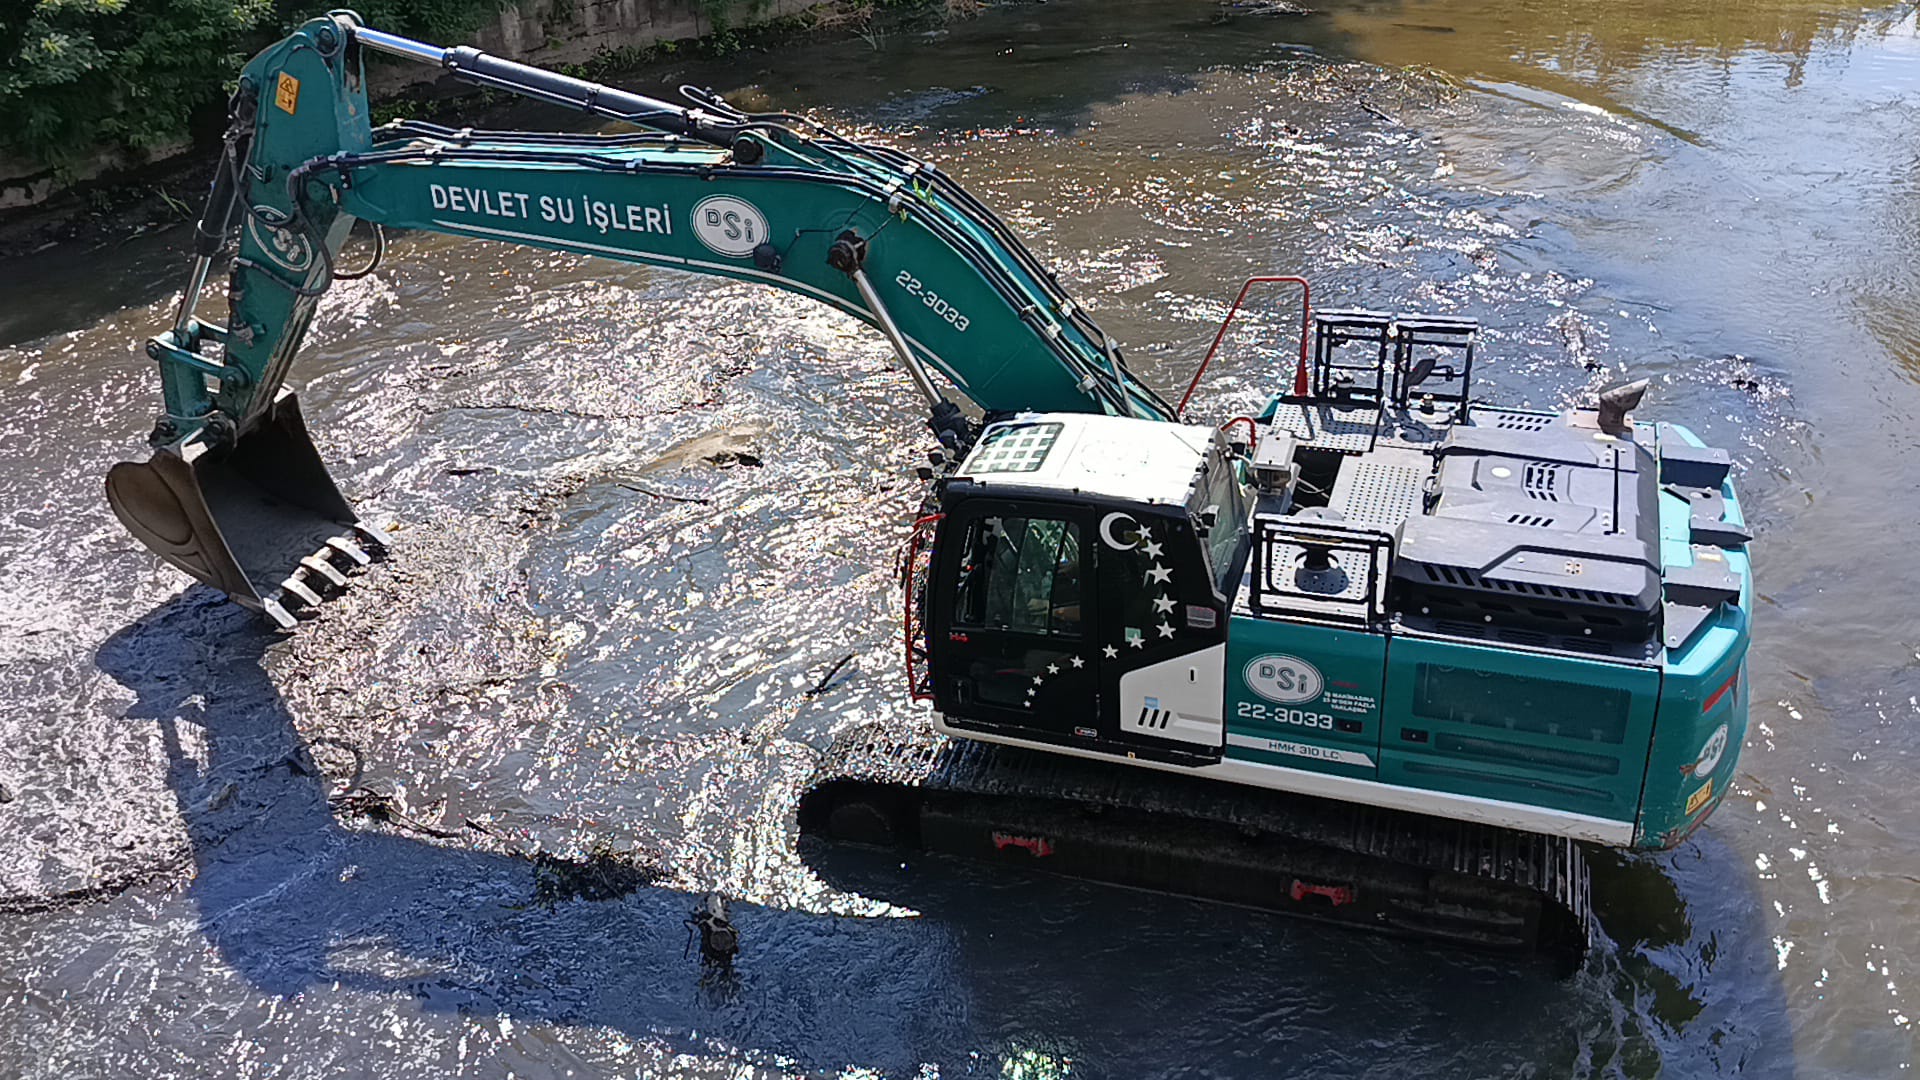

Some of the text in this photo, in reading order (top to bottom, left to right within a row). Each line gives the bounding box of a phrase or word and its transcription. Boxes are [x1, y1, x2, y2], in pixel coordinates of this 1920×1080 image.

[430, 184, 672, 235] DEVLET SU İŞLERİ
[895, 269, 970, 332] 22-3033
[1237, 701, 1333, 730] 22-3033
[1268, 741, 1340, 760] HMK 310 LC
